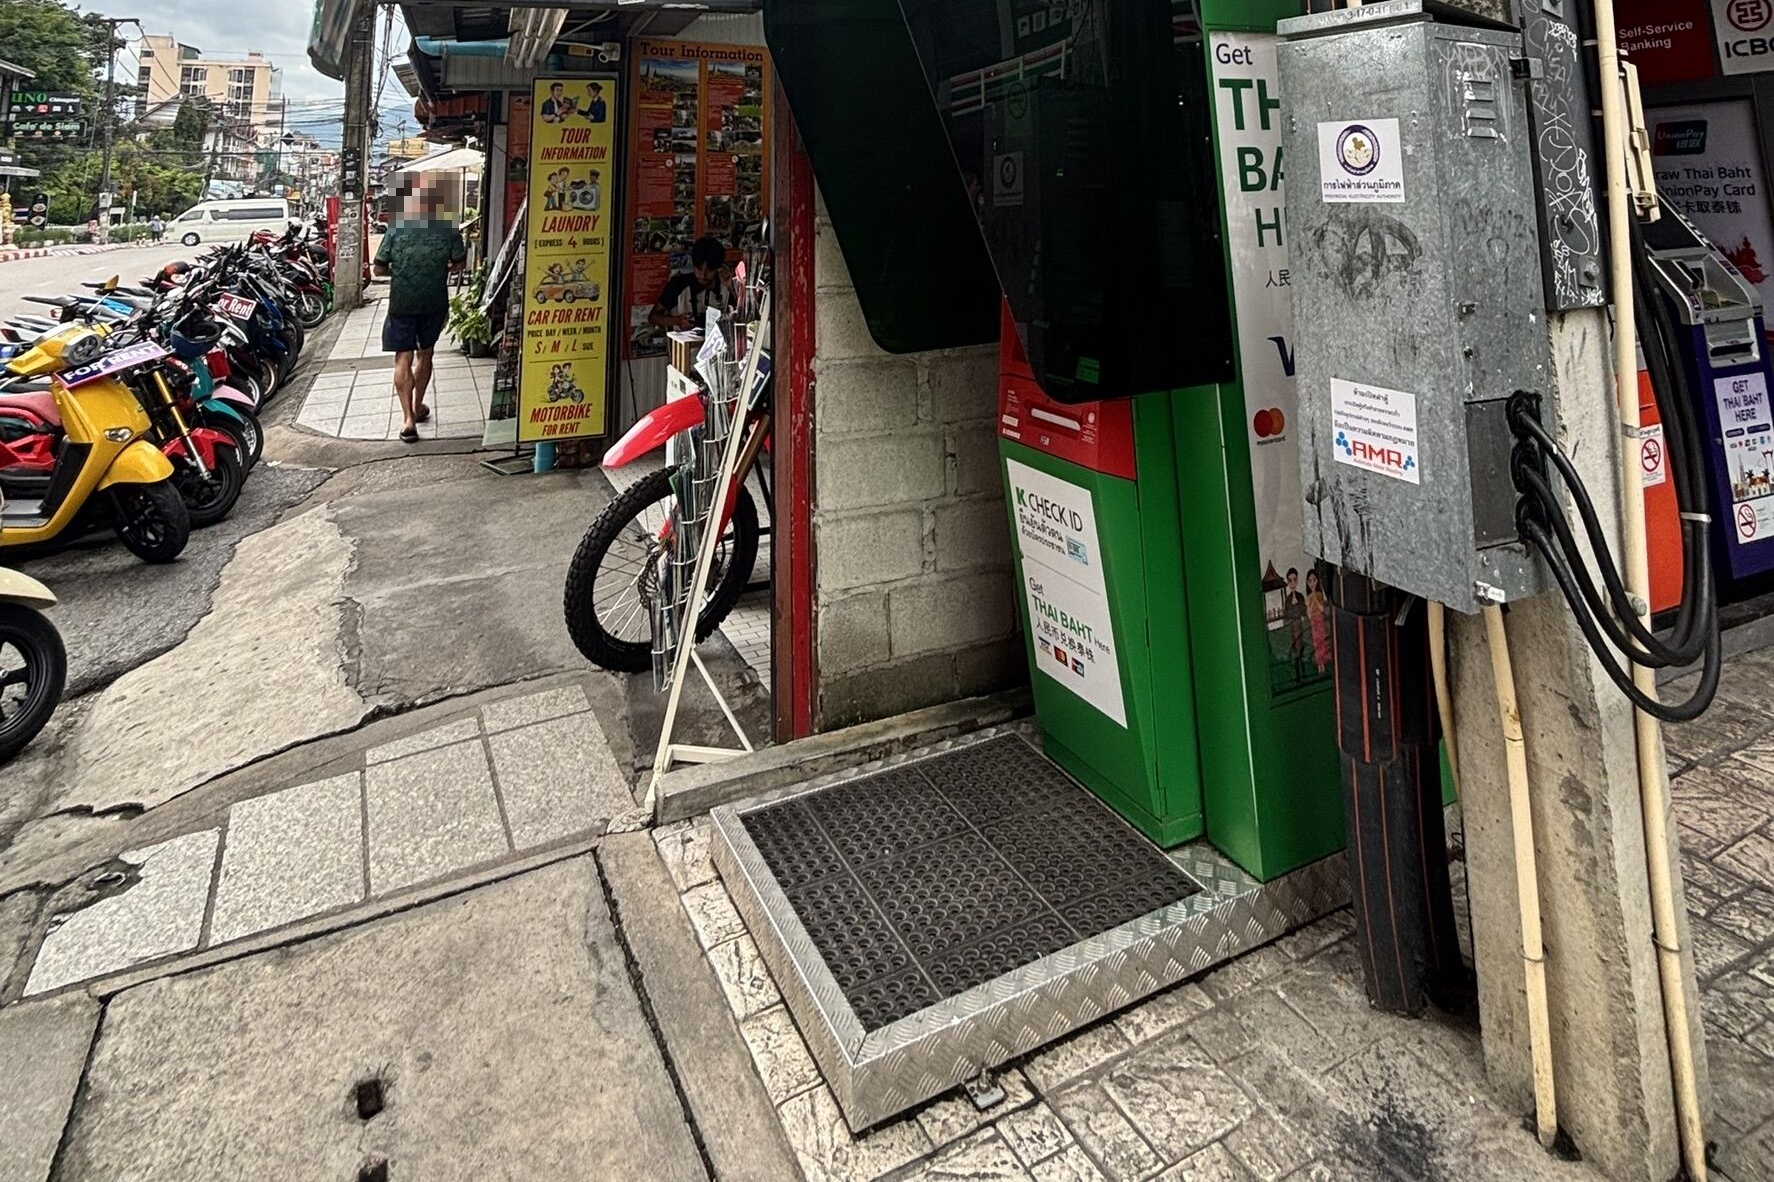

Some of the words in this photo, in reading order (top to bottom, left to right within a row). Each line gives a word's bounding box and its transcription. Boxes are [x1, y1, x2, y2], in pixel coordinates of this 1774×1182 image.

[1619, 21, 1693, 39] Self-Service
[640, 42, 675, 57] Tour
[681, 45, 764, 61] Information
[1621, 37, 1672, 51] Banking
[1216, 43, 1253, 66] Get
[39, 122, 53, 130] de
[55, 122, 80, 131] Siam
[561, 128, 592, 144] TOUR
[541, 146, 607, 160] INFORMATION
[1683, 167, 1714, 179] Thai
[1718, 167, 1751, 179] Baht
[1661, 184, 1719, 198] nionPay
[1723, 184, 1756, 196] Card
[542, 215, 600, 233] LAUNDRY
[568, 236, 577, 249] 4
[229, 300, 252, 317] Rent
[527, 310, 548, 325] CAR
[551, 308, 572, 324] FOR
[574, 307, 602, 323] RENT
[527, 329, 543, 338] PRICE
[545, 328, 556, 337] DAY
[562, 327, 577, 336] WEEK
[551, 340, 560, 353] M
[572, 339, 577, 351] L
[63, 358, 104, 381] FOR
[108, 344, 156, 366] RENT
[1732, 380, 1749, 393] GET
[1723, 397, 1741, 411] THAI
[1742, 392, 1763, 407] BAHT
[530, 403, 592, 423] MOTORBIKE
[1735, 408, 1757, 422] HERE
[542, 424, 560, 436] FOR
[561, 422, 581, 435] RENT
[1352, 440, 1403, 469] AMR
[1015, 486, 1027, 508] K
[1028, 493, 1068, 527] CHECK
[1069, 509, 1083, 532] ID
[1029, 577, 1044, 596] Get
[1032, 594, 1059, 623] THAI
[1060, 610, 1093, 644] BAHT
[1094, 637, 1111, 654] Here
